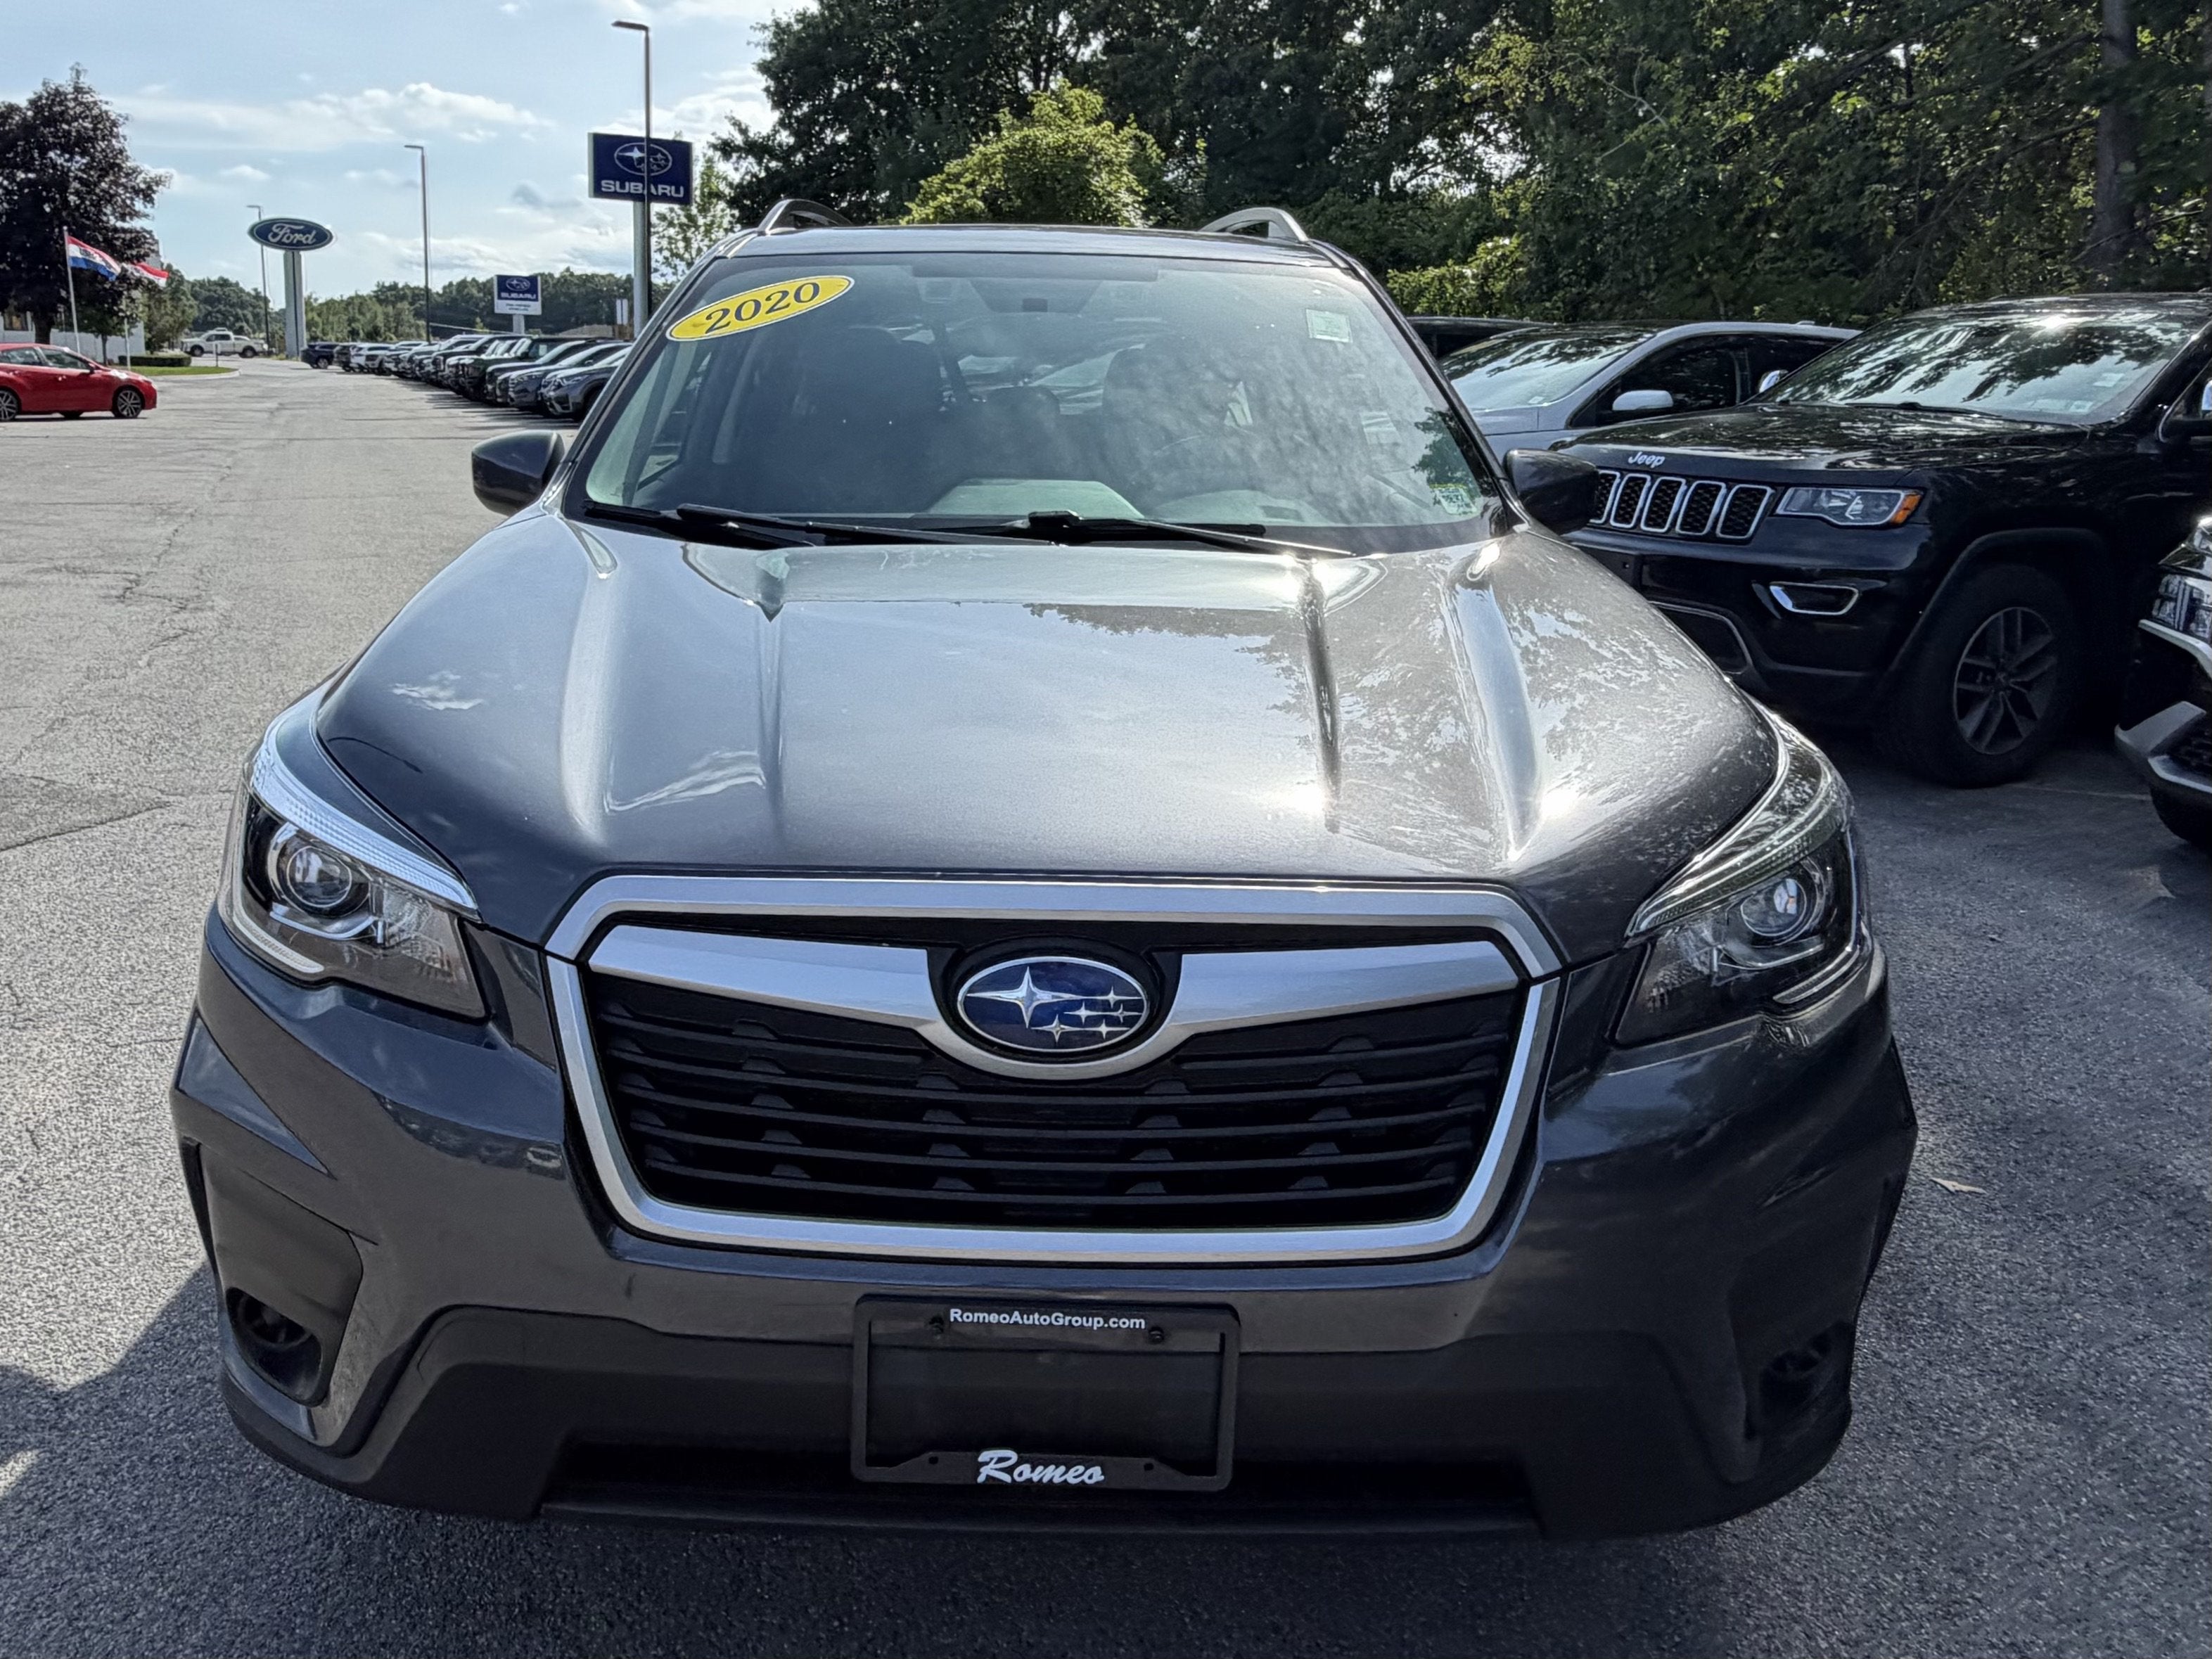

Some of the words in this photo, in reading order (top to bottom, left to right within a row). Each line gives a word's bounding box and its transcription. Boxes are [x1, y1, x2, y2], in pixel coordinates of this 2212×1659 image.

[268, 223, 317, 244] Ford
[705, 282, 820, 334] 2020
[1628, 451, 1666, 468] Jeep
[950, 1308, 1146, 1330] RomeoAutoGroup.com
[977, 1449, 1104, 1485] Romeo
